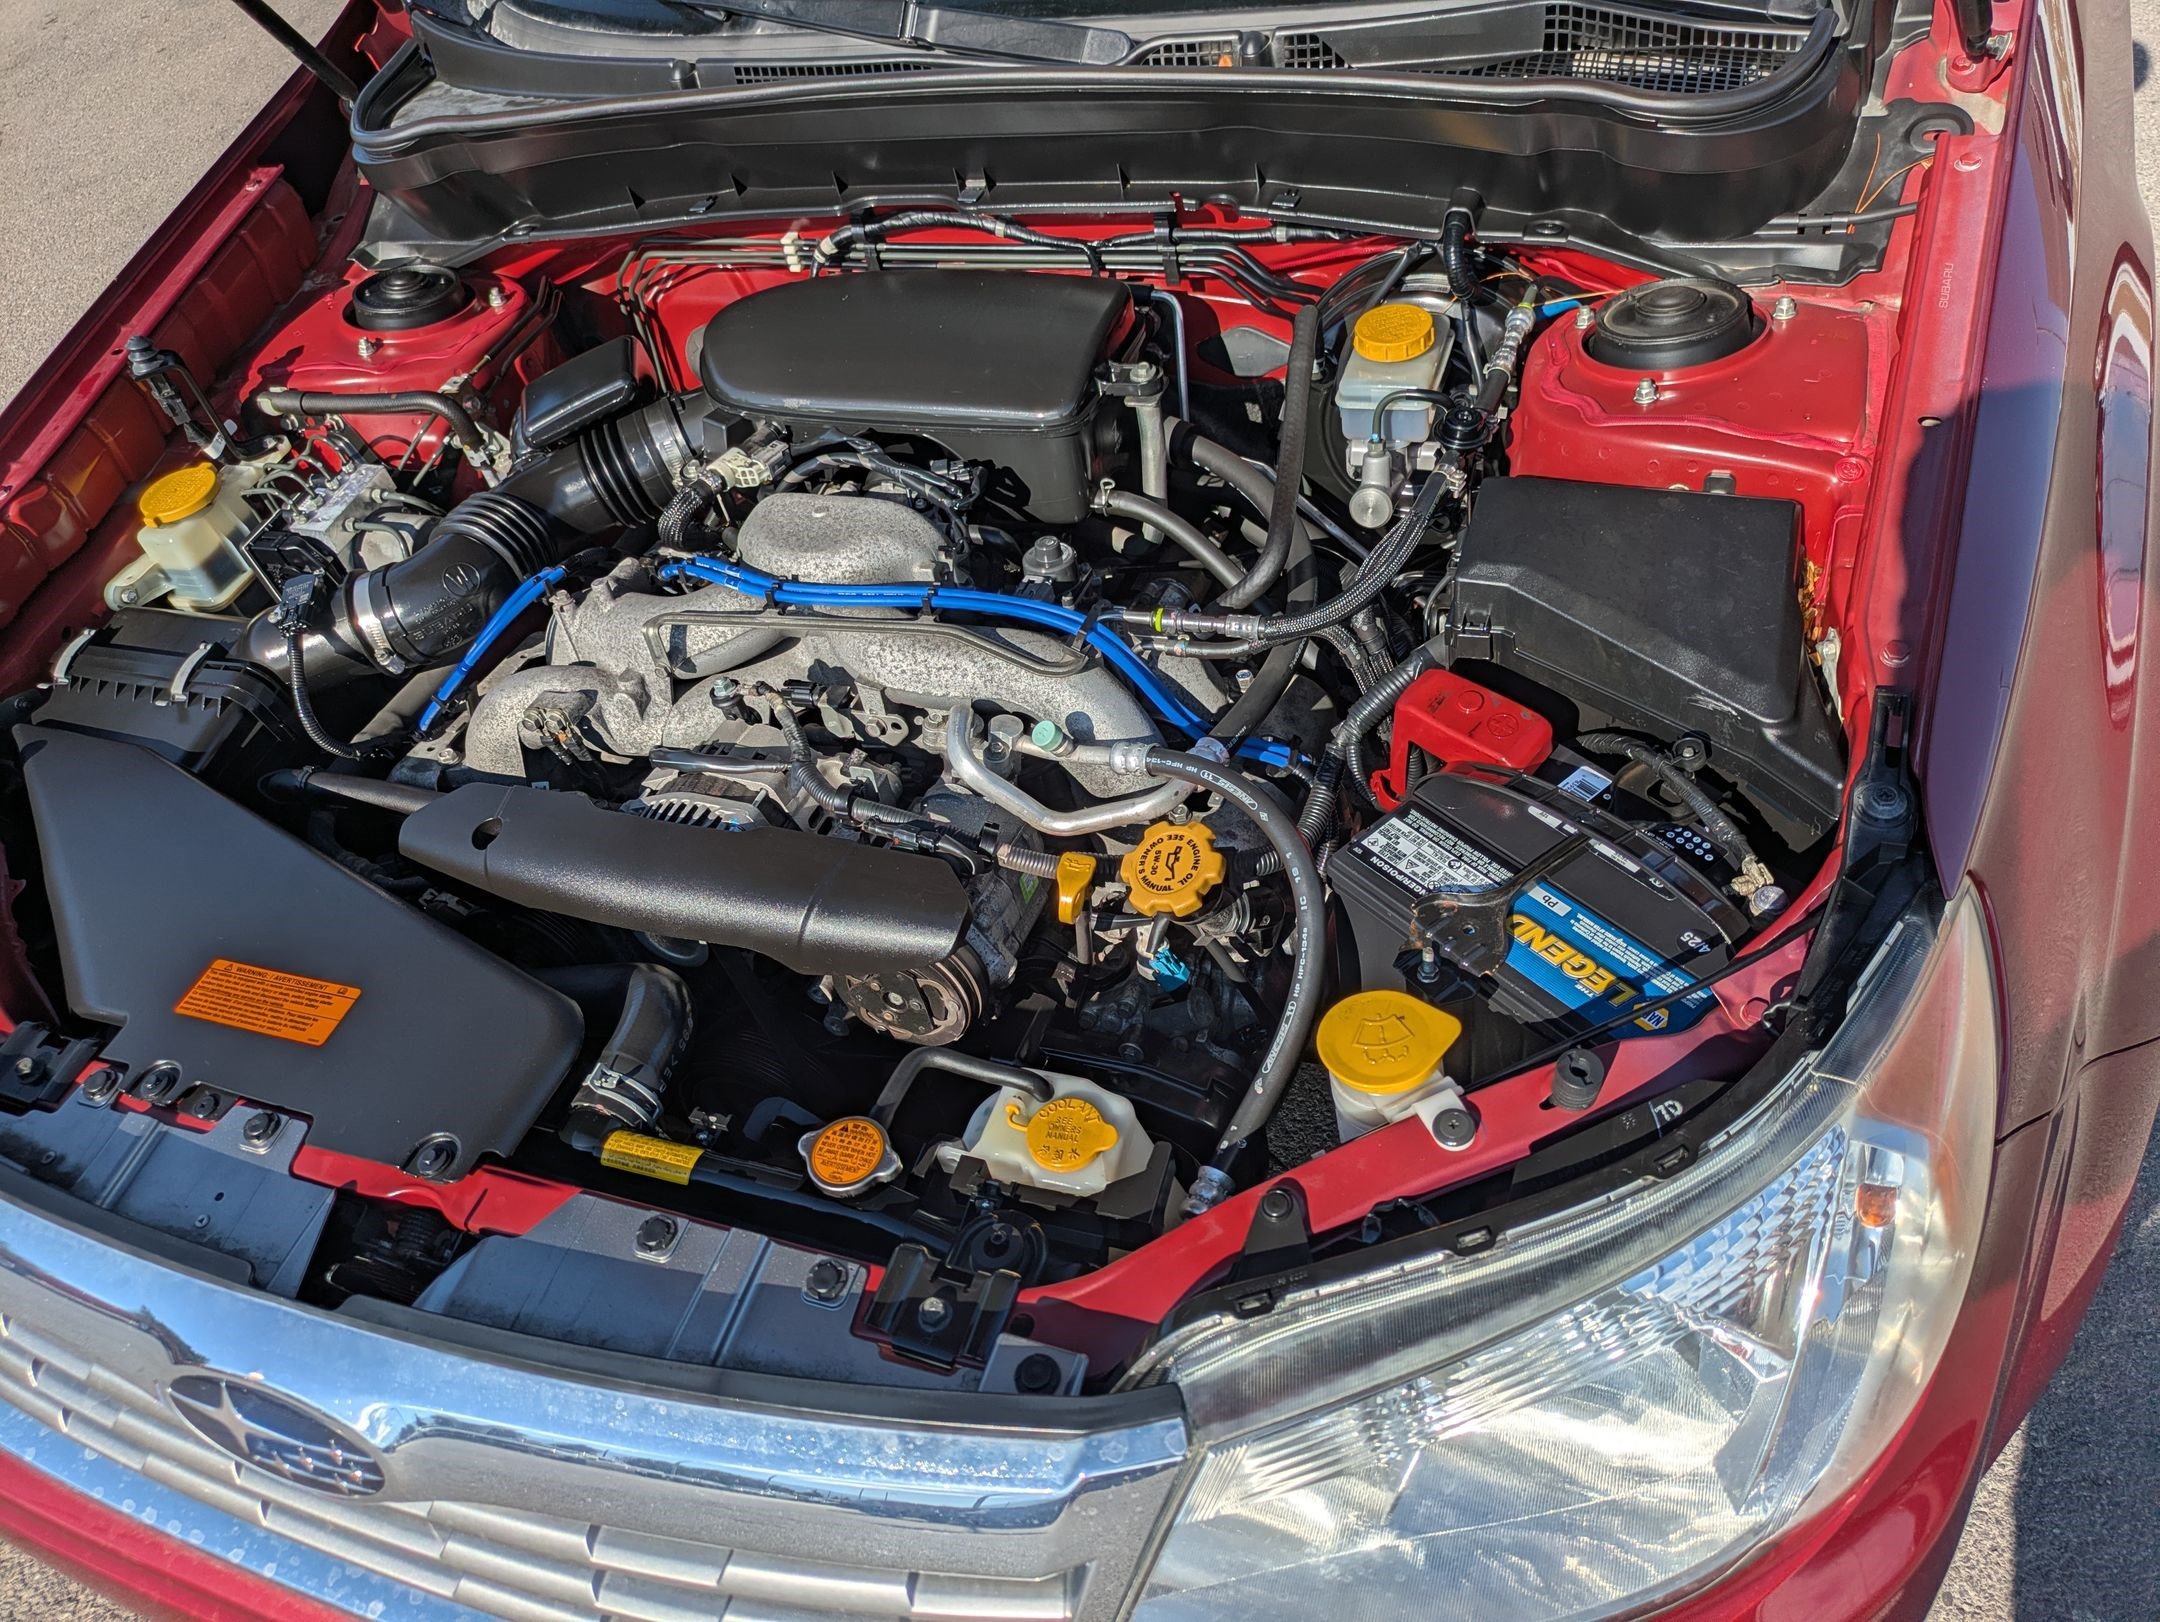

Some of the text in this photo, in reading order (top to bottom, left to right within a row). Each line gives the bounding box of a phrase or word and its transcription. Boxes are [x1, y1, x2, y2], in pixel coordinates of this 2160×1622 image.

[1938, 262, 1954, 309] SUBARU
[1166, 834, 1185, 842] SEE
[1150, 850, 1162, 876] 5W-30
[1177, 839, 1201, 886] ENGINE OIL
[1140, 876, 1174, 892] MANUAL
[1370, 856, 1426, 896] NGER/POISON
[1542, 894, 1558, 910] Pb
[1681, 931, 1711, 953] 4/25
[1506, 913, 1640, 1008] LEGEND
[274, 972, 329, 991] AVERTISSEMENT
[1039, 1098, 1102, 1124] COOLANT
[1046, 1131, 1079, 1143] MANUAL
